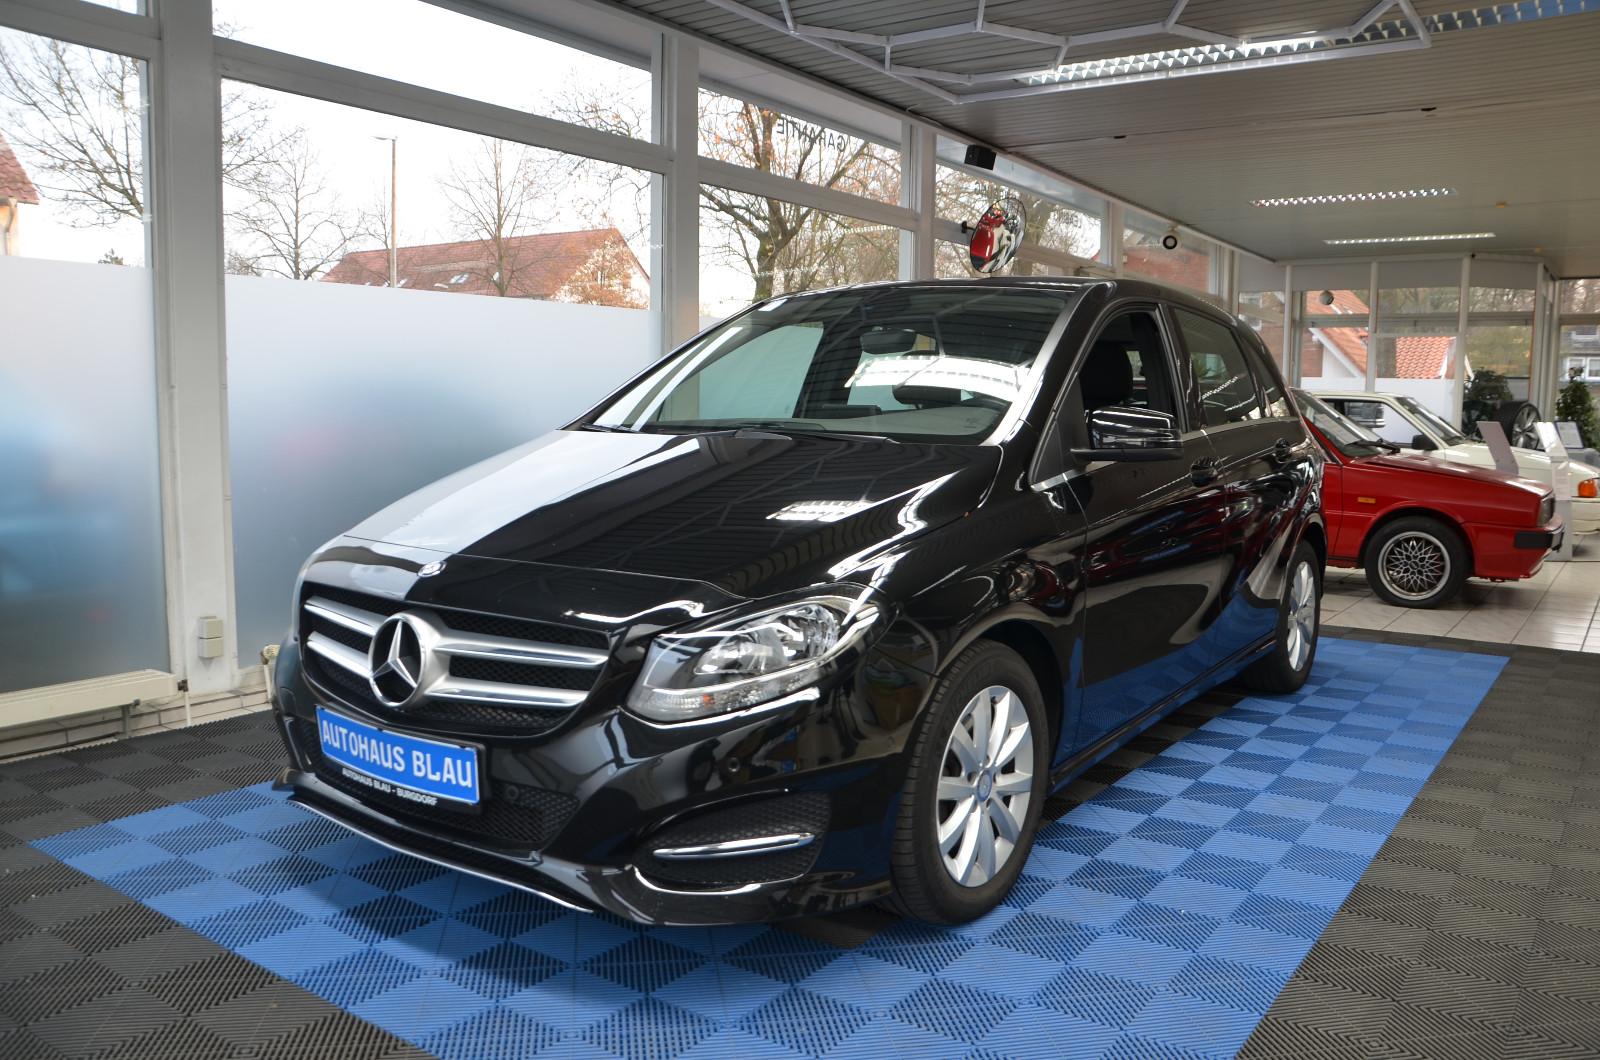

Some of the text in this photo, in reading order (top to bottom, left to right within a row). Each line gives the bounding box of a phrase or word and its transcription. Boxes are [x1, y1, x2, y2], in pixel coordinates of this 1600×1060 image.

[322, 719, 473, 788] AUTOHAUS BLAU
[342, 767, 373, 787] AUTOHAUS
[374, 780, 391, 793] BLAU
[396, 787, 438, 806] BURGDORF
